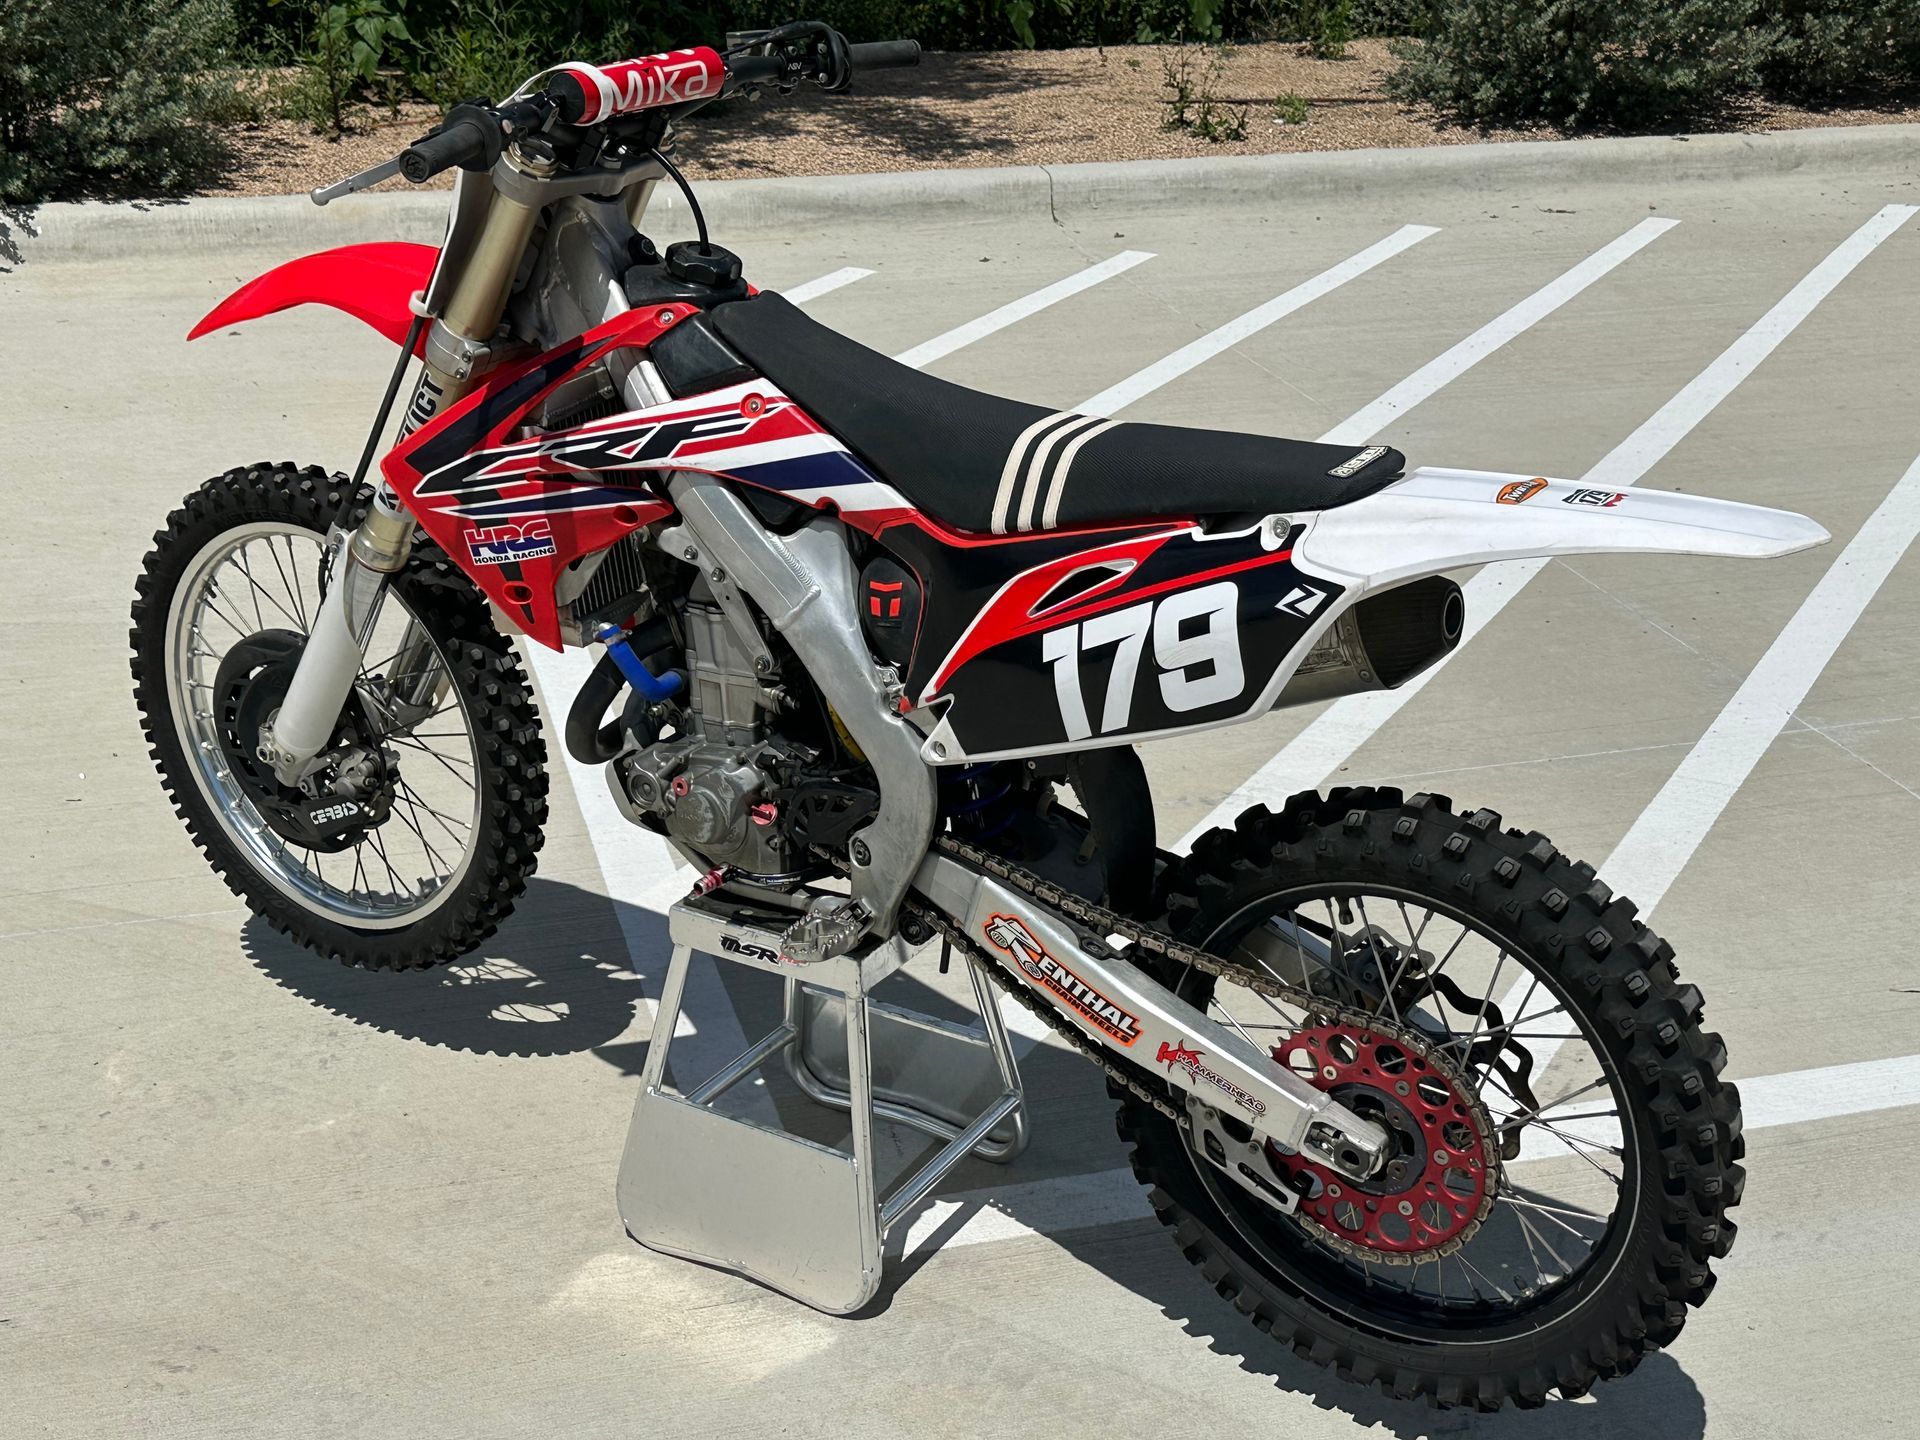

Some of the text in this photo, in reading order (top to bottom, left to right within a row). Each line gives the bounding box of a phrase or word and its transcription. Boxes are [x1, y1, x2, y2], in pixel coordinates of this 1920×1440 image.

[464, 519, 555, 557] HRC
[474, 547, 556, 565] HONDA RACING
[1042, 581, 1245, 742] 179
[1043, 976, 1132, 1044] CHAINWHEELS
[1175, 1051, 1267, 1113] HAMMERHEAD
